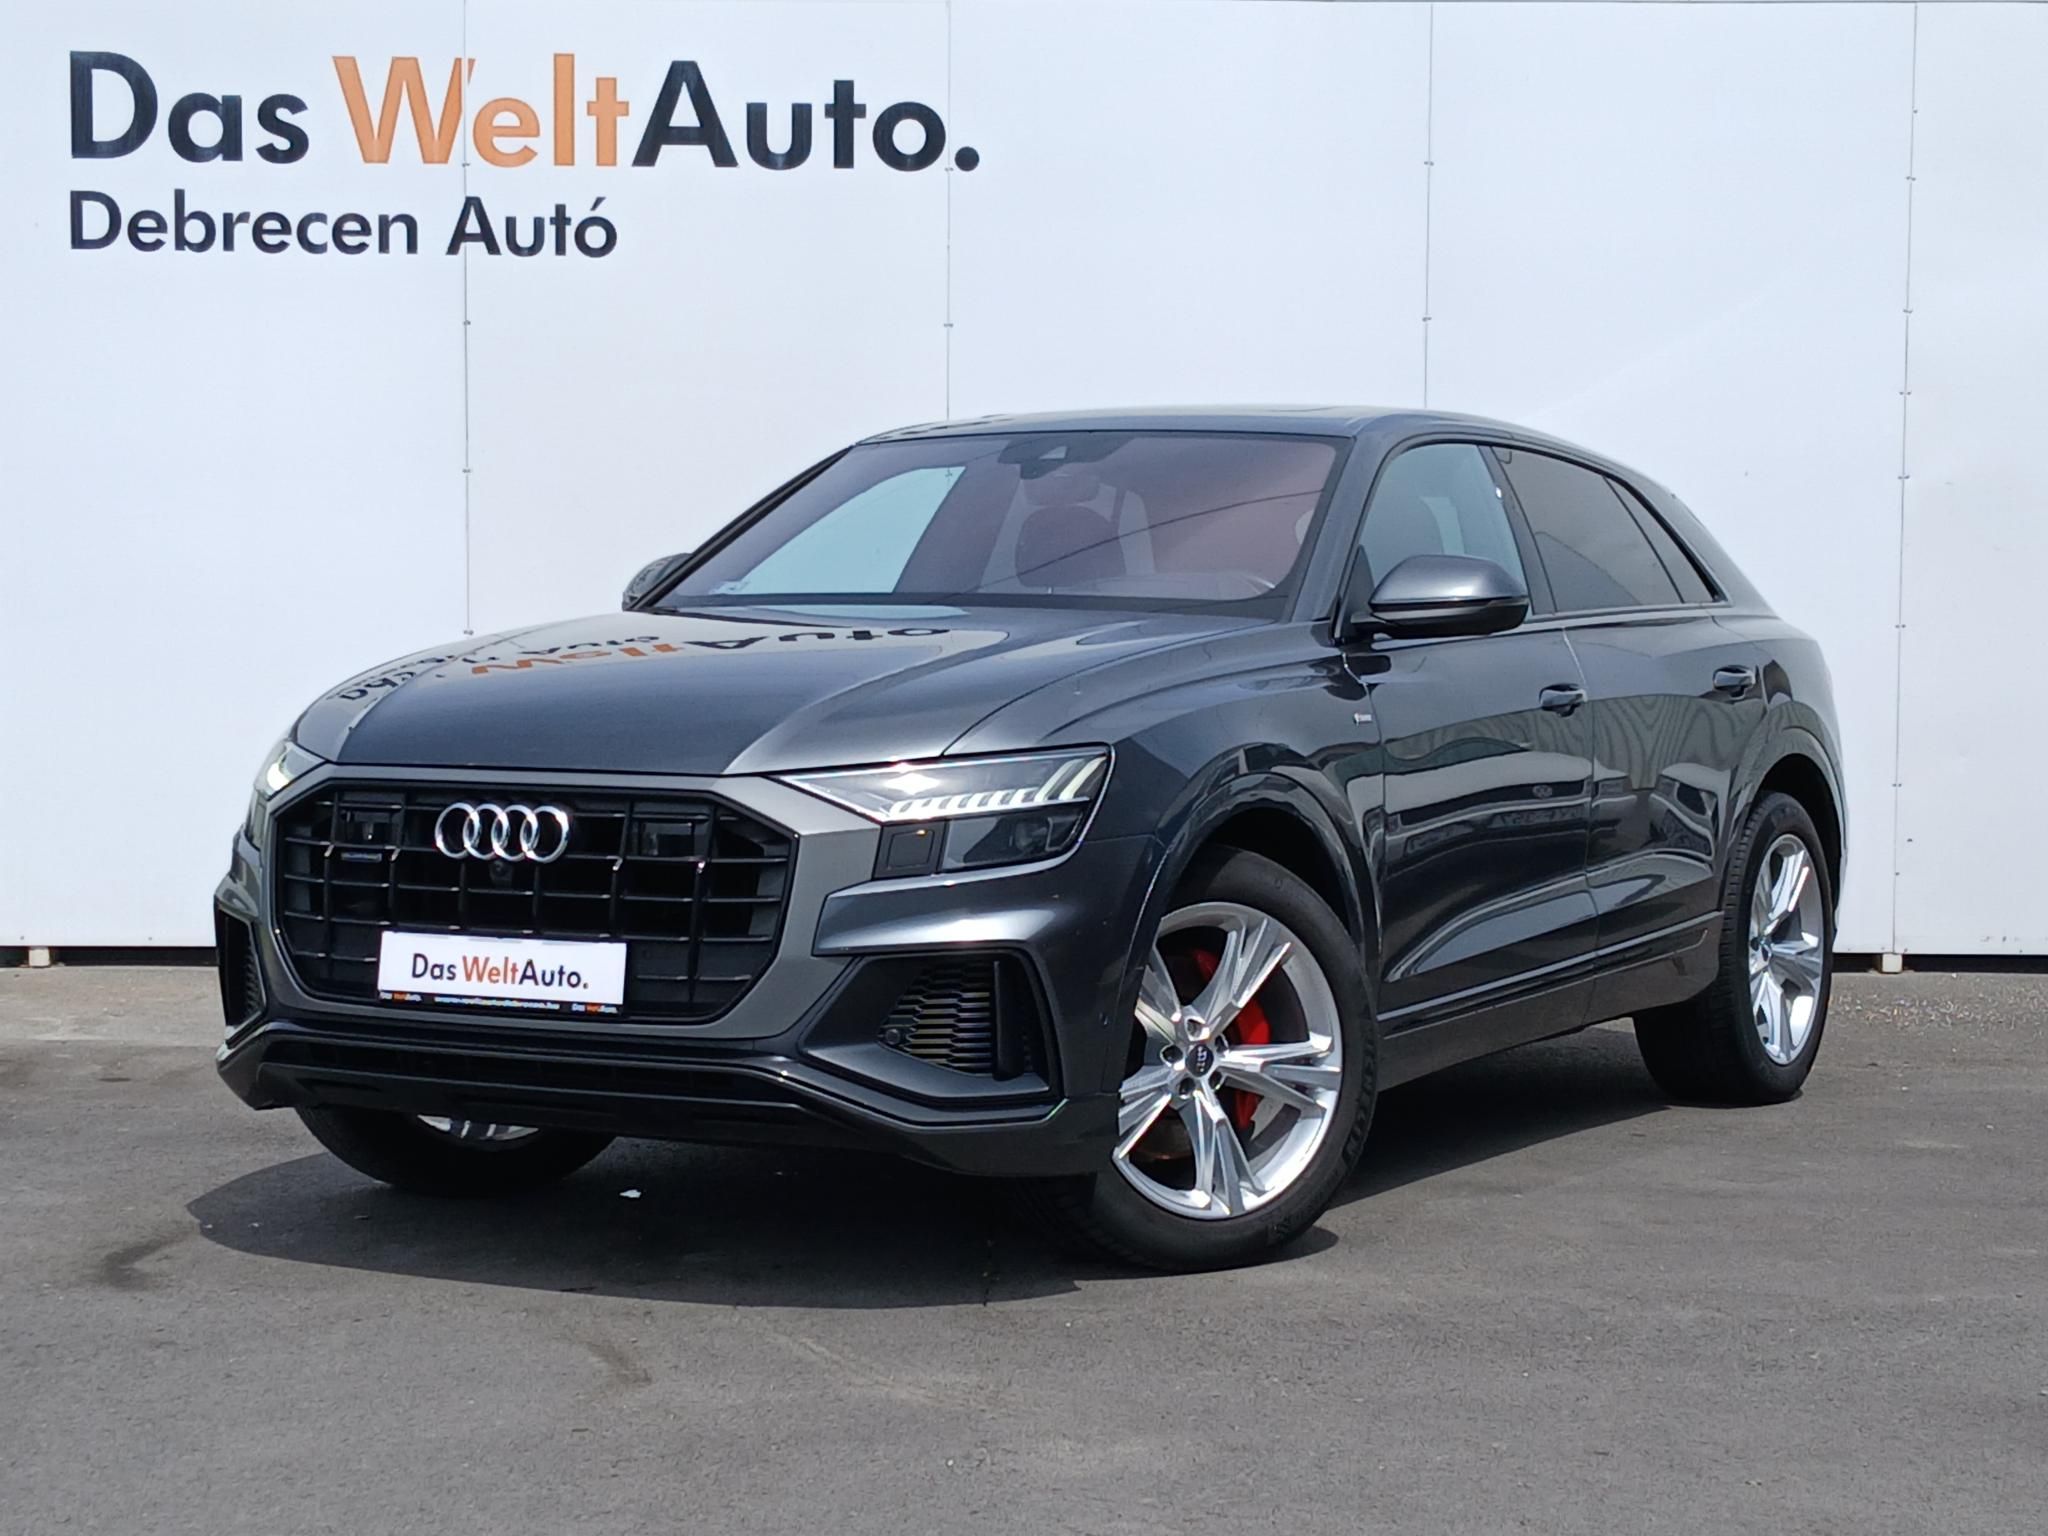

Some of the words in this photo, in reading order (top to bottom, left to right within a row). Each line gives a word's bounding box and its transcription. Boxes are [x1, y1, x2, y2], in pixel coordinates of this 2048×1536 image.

[70, 51, 309, 164] Das
[332, 53, 980, 171] WeltAuto.
[70, 189, 417, 254] Debrecen
[446, 196, 618, 258] Autó
[411, 952, 457, 981] Das
[461, 955, 589, 990] WeltAuto.
